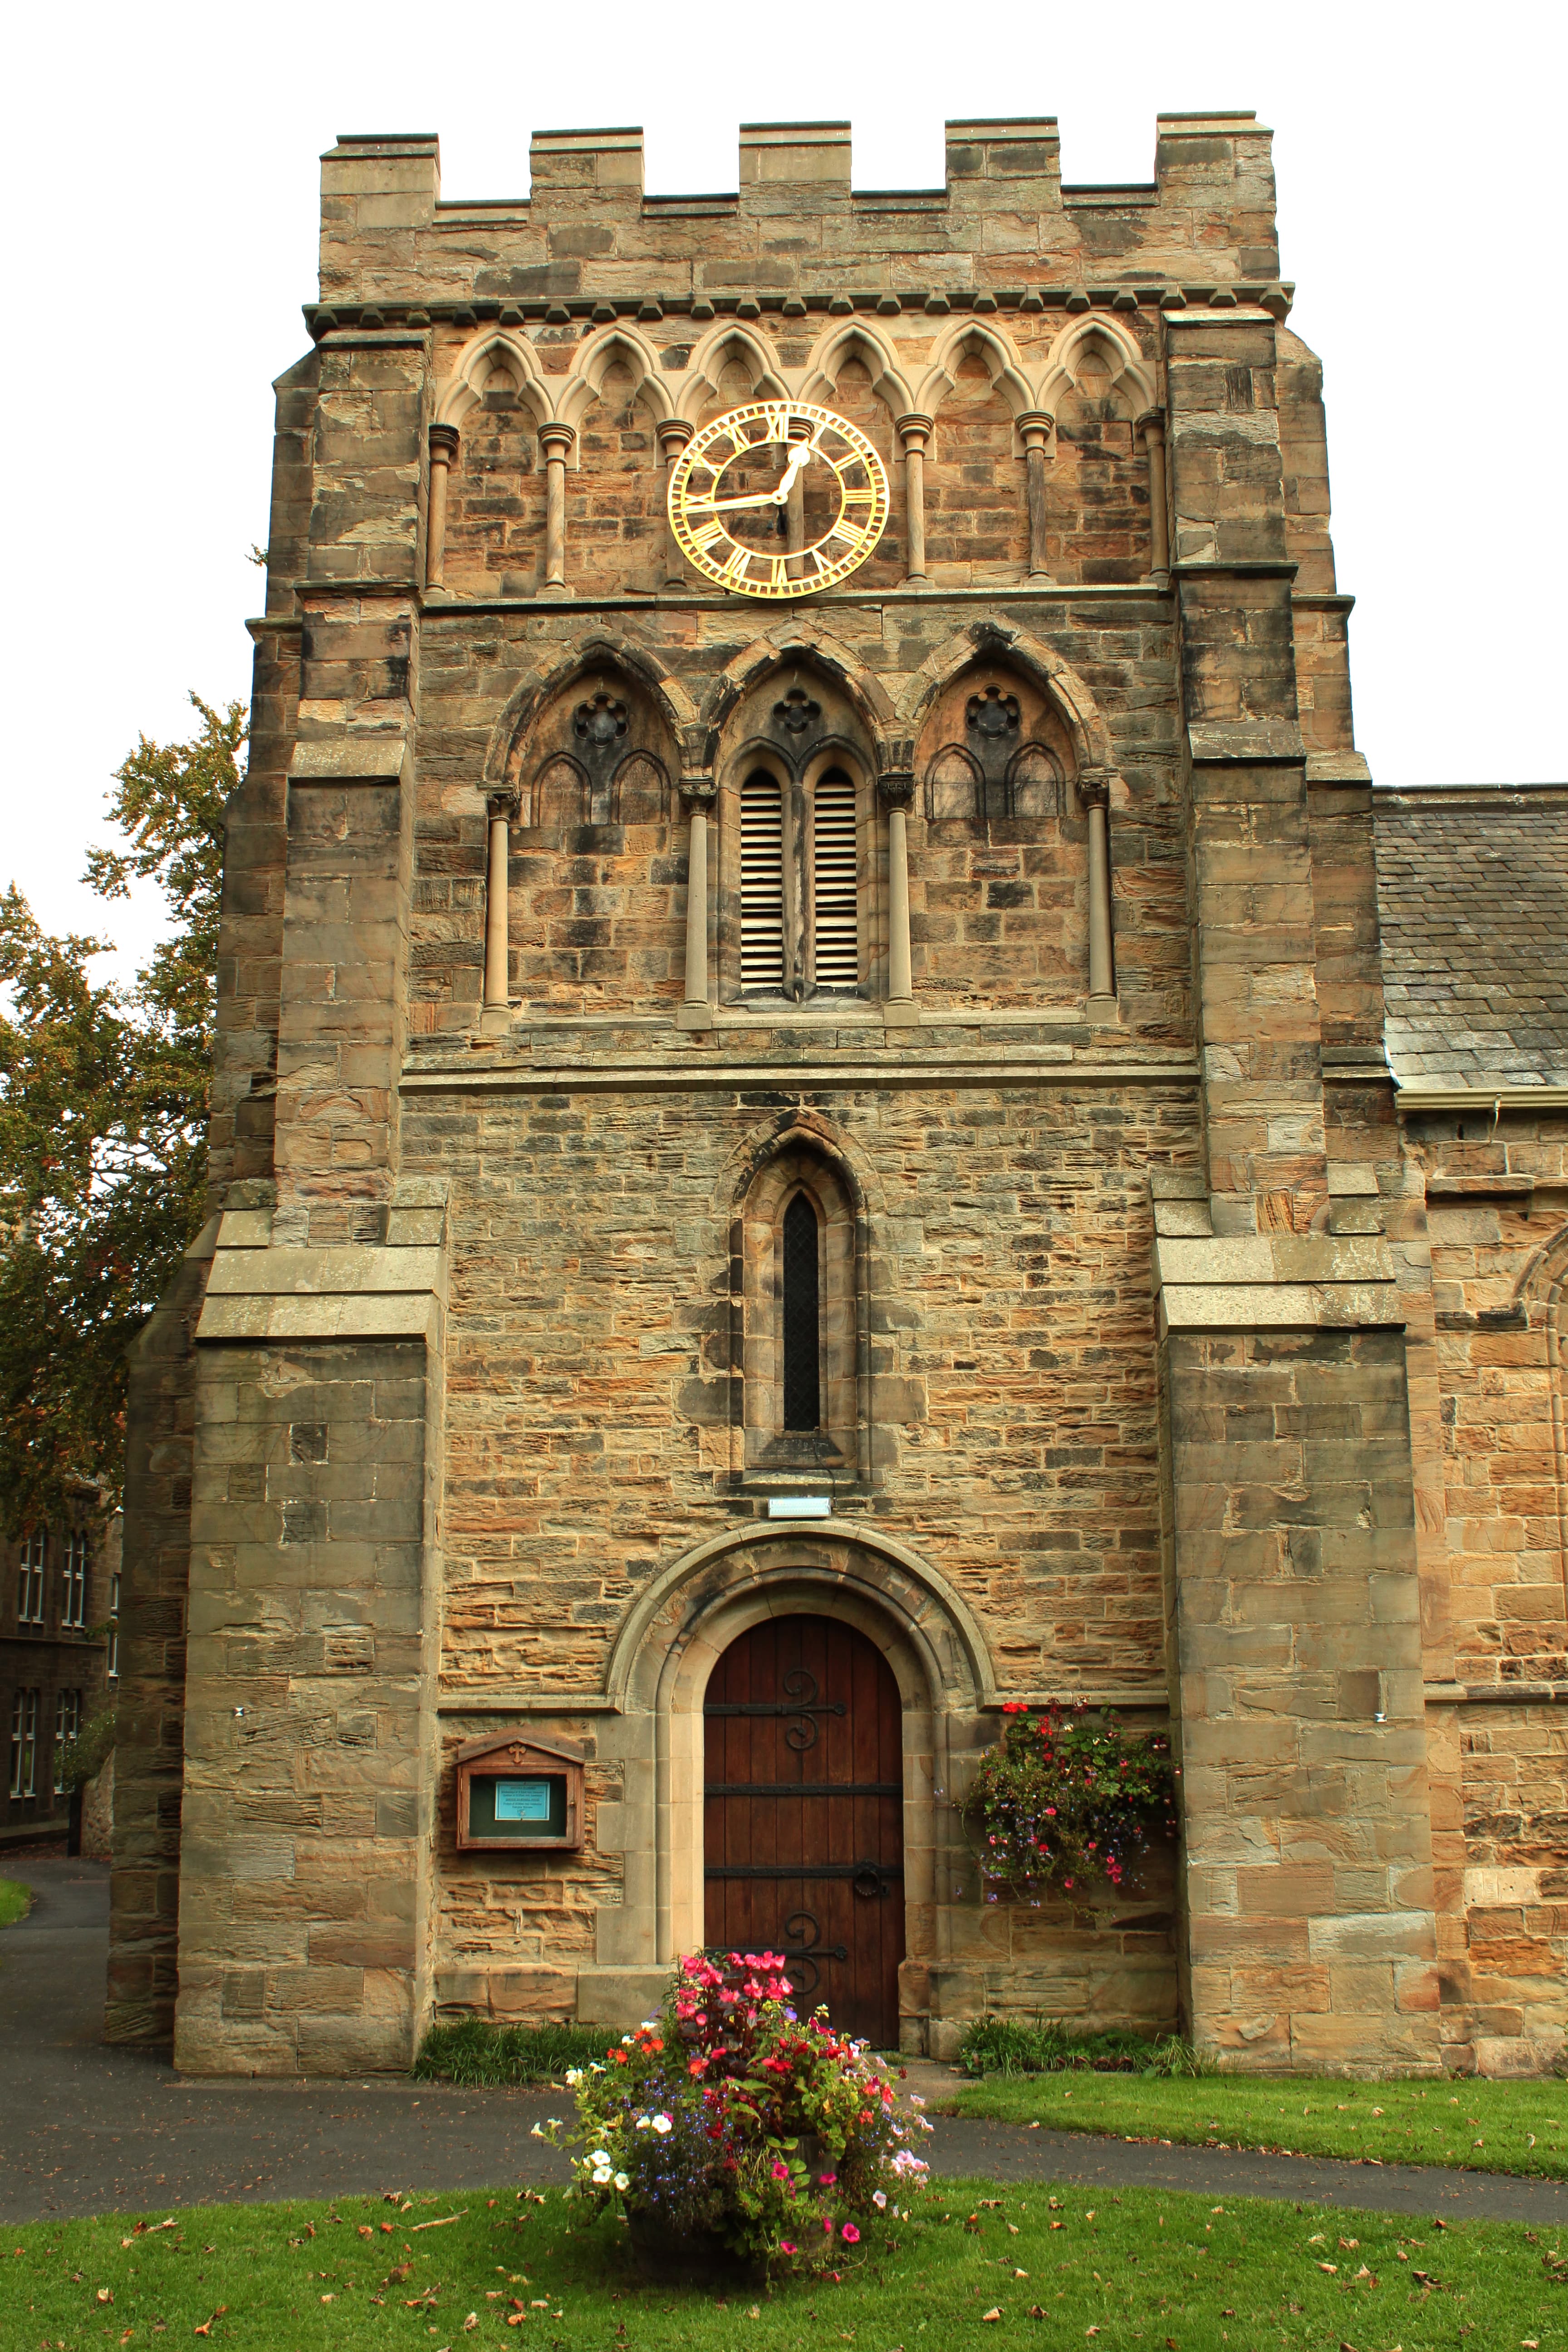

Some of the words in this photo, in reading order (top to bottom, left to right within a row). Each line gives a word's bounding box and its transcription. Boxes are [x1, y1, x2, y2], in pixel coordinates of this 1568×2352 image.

[725, 425, 751, 453] XI
[765, 415, 789, 441] XII
[693, 453, 725, 476] X
[834, 450, 862, 472] II
[845, 489, 872, 504] III
[692, 520, 725, 551] VIII
[833, 519, 866, 547] IIII
[723, 547, 751, 579] VII
[771, 559, 788, 583] VI
[812, 549, 835, 574] V
